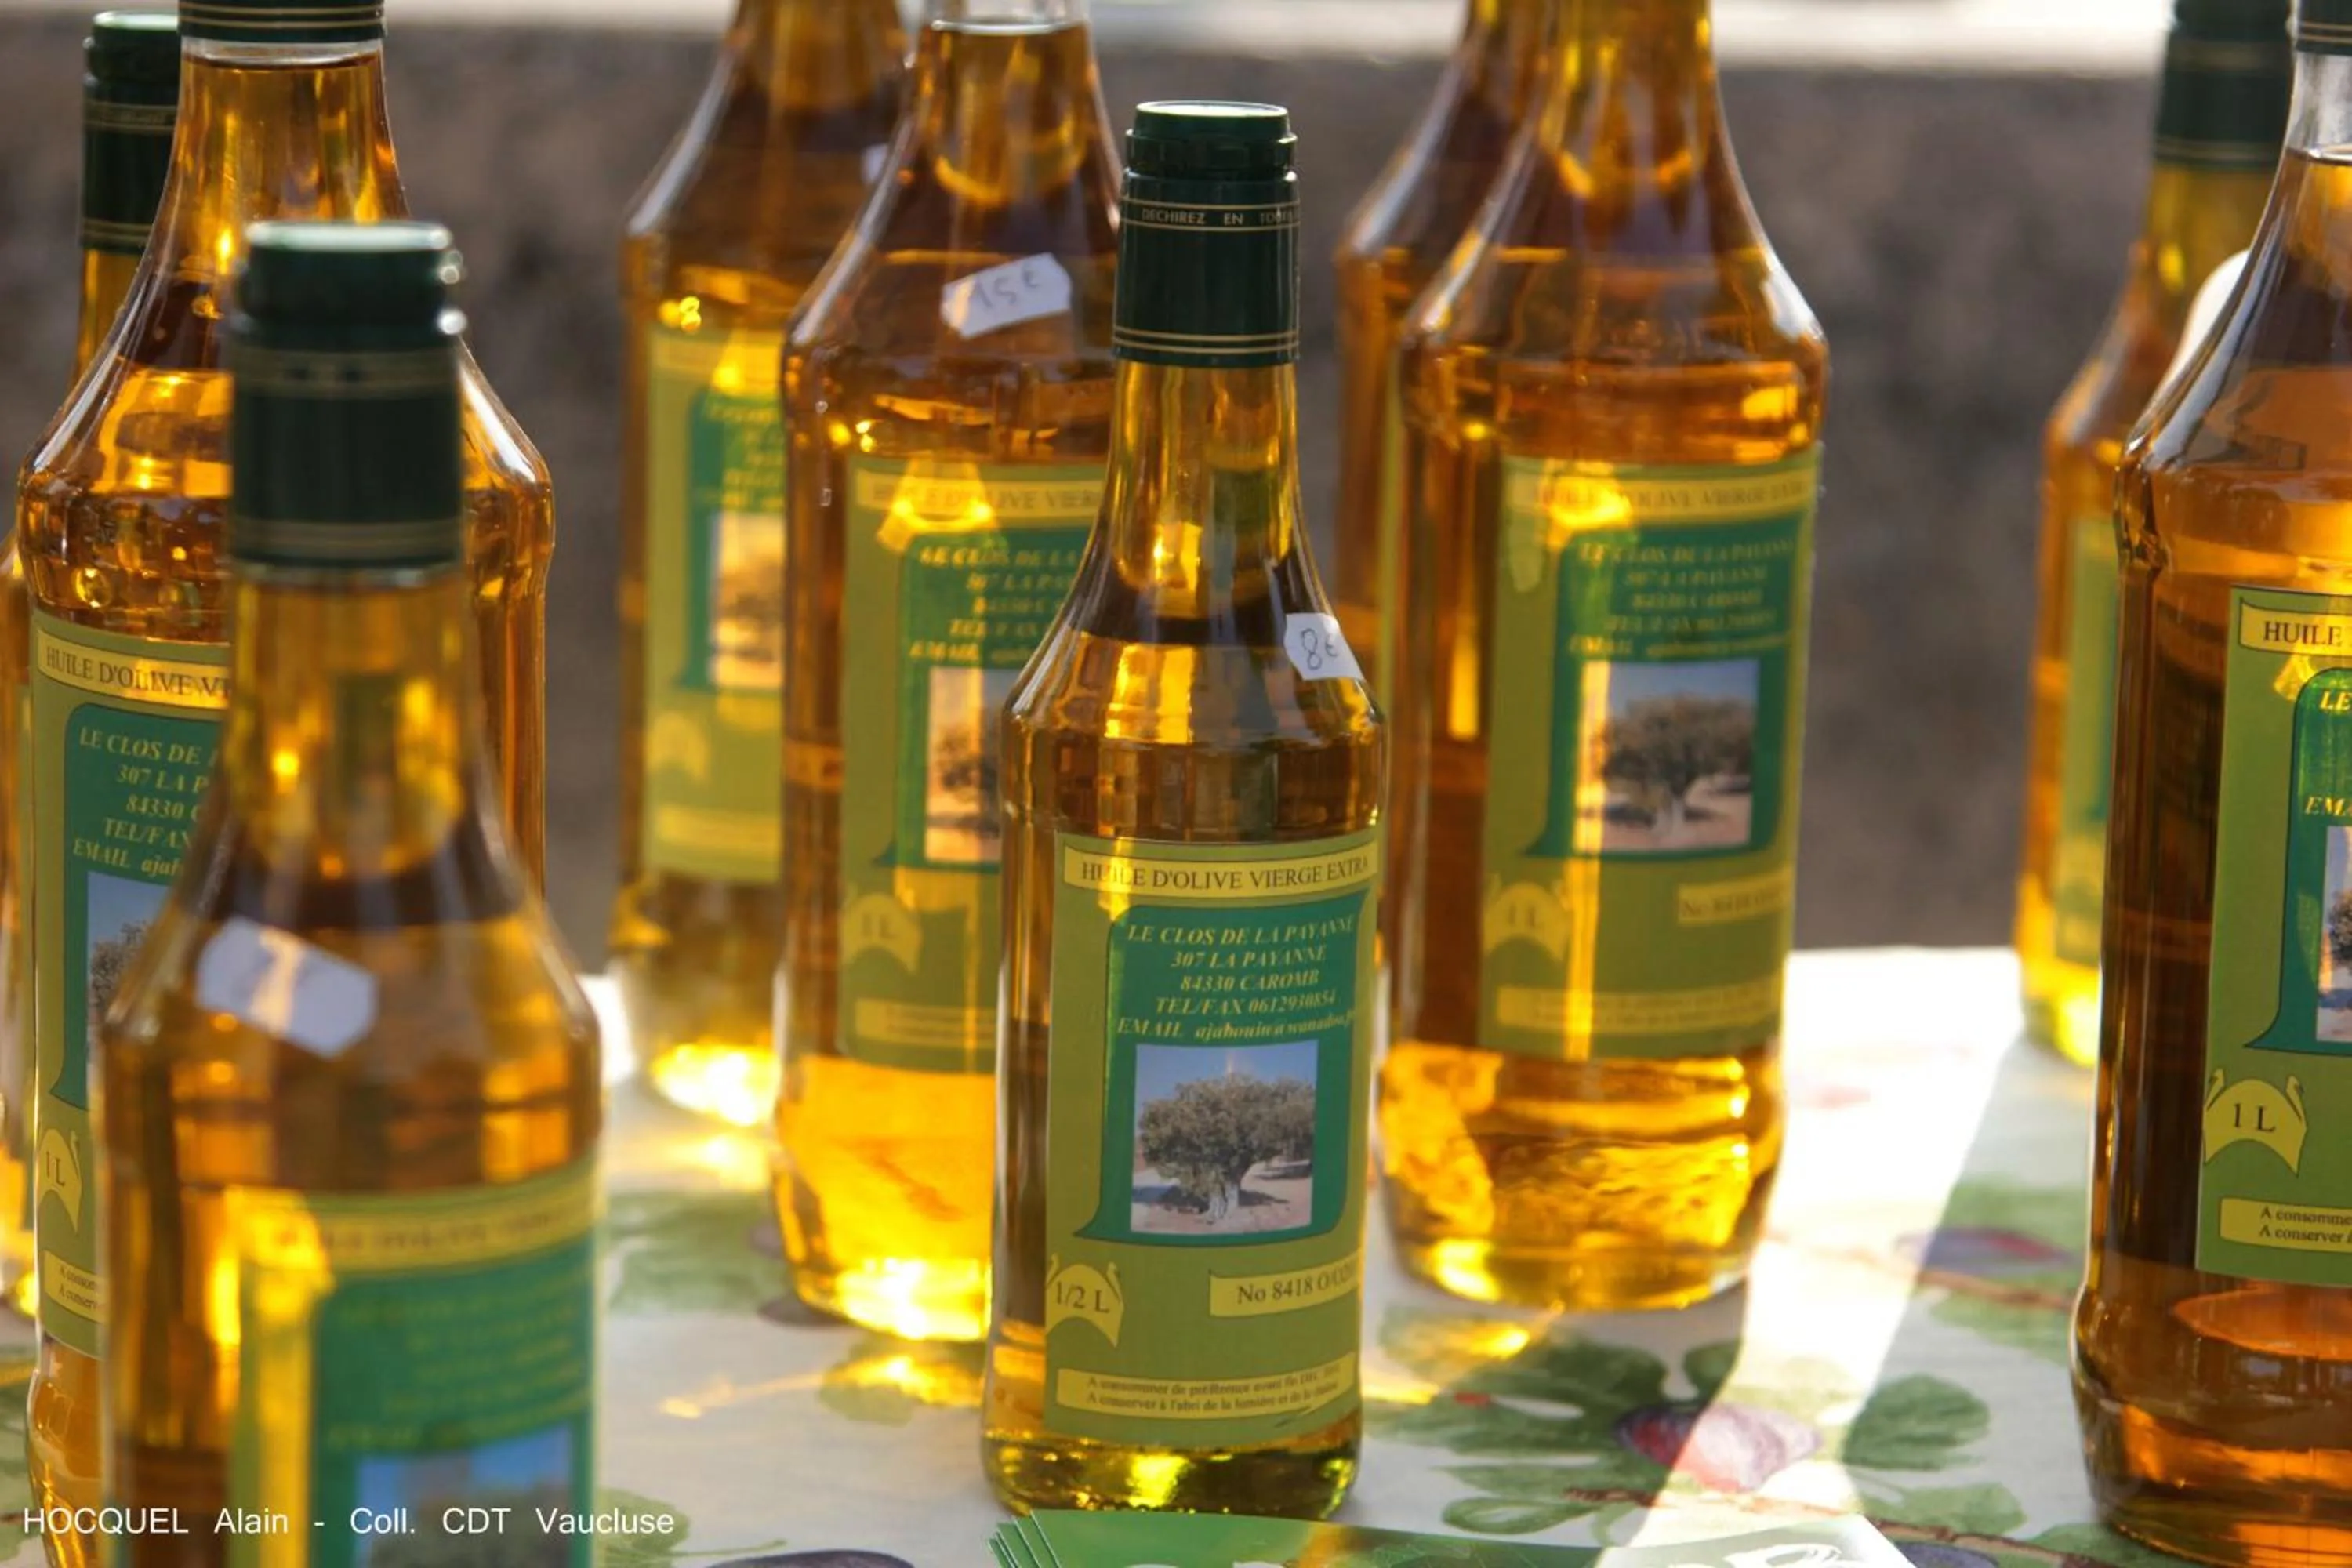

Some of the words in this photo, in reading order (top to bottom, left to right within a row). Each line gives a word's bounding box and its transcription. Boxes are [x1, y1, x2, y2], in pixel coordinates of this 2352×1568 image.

[1224, 212, 1244, 226] EN
[2263, 621, 2343, 647] HUILE
[46, 645, 95, 680] HUILE
[99, 661, 194, 697] D'OLIVE
[2318, 689, 2352, 711] LE
[79, 725, 103, 747] LE
[107, 734, 163, 761] CLOS
[168, 742, 201, 766] DE
[73, 838, 131, 869] EMAIL
[1082, 861, 1145, 887] HUILE
[1152, 868, 1243, 891] D'OLIVE
[1250, 865, 1323, 889] VIERGE
[1327, 855, 1370, 883] EXTRA
[1127, 924, 1155, 942] LE
[1160, 926, 1216, 946] CLOS
[1221, 928, 1250, 946] DE
[1255, 927, 1279, 946] LA
[1284, 914, 1355, 943] PAYANNE
[1171, 950, 1205, 968] 307
[1209, 952, 1236, 969] LA
[1242, 945, 1327, 968] PAYANNE
[1180, 975, 1235, 993] 84330
[1240, 969, 1320, 992] CAROMB
[1156, 996, 1243, 1016] TEL/FAX
[1117, 1017, 1184, 1036] EMAIL
[2275, 1210, 2352, 1226] consomme
[1055, 1280, 1086, 1310] 1/2
[1094, 1290, 1110, 1314] L
[1236, 1283, 1267, 1305] No
[1272, 1276, 1314, 1301] 8418
